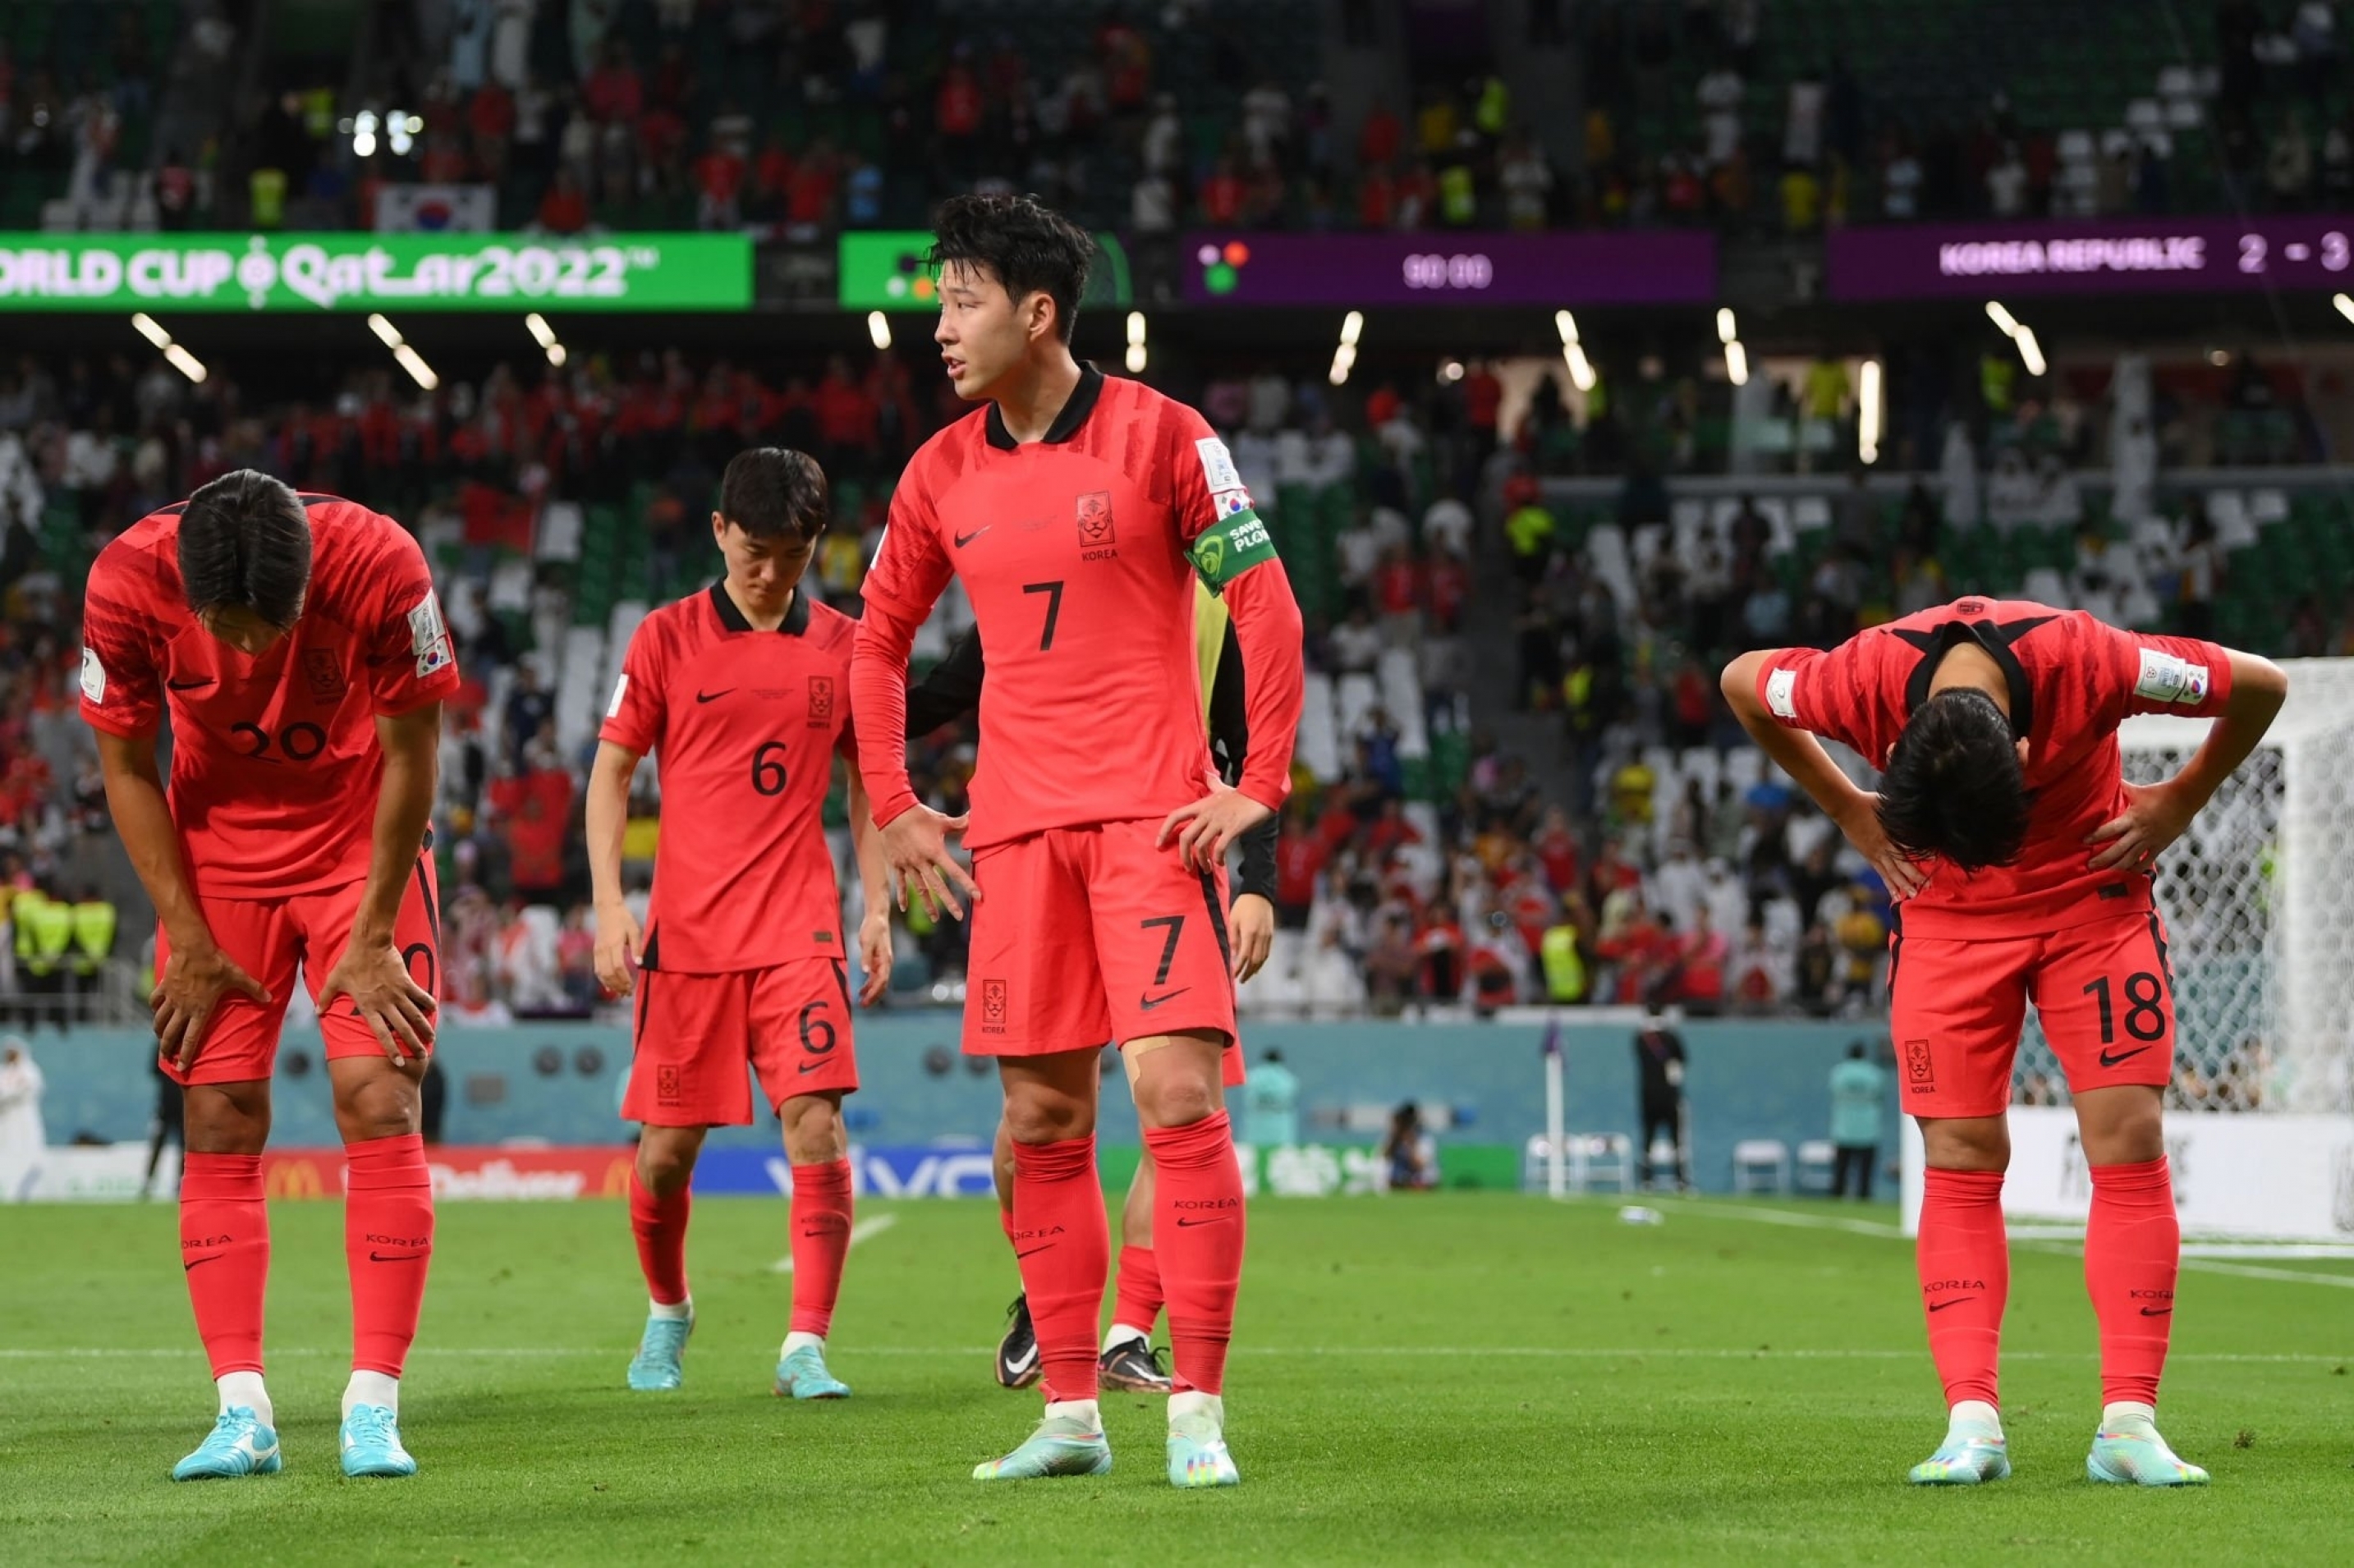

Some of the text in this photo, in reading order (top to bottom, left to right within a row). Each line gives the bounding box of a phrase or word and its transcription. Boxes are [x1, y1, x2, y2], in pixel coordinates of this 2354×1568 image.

[126, 249, 235, 297] CUP
[1939, 241, 2045, 275] KOREA
[2047, 236, 2206, 272] REPUBLIC
[2238, 233, 2268, 273] 2
[2320, 231, 2351, 272] 3
[1229, 519, 1263, 541] SAVE
[1081, 548, 1118, 562] KOREA
[1022, 580, 1065, 652] 7
[229, 721, 327, 765] 20
[751, 740, 787, 796] 6
[1140, 915, 1185, 986] 7
[798, 1000, 837, 1055] 6
[2083, 971, 2166, 1043] 18
[1911, 1085, 1936, 1094] KOREA
[1174, 1198, 1237, 1209] KOREA
[365, 1233, 429, 1247] KOREA
[1924, 1279, 1985, 1295] KOREA
